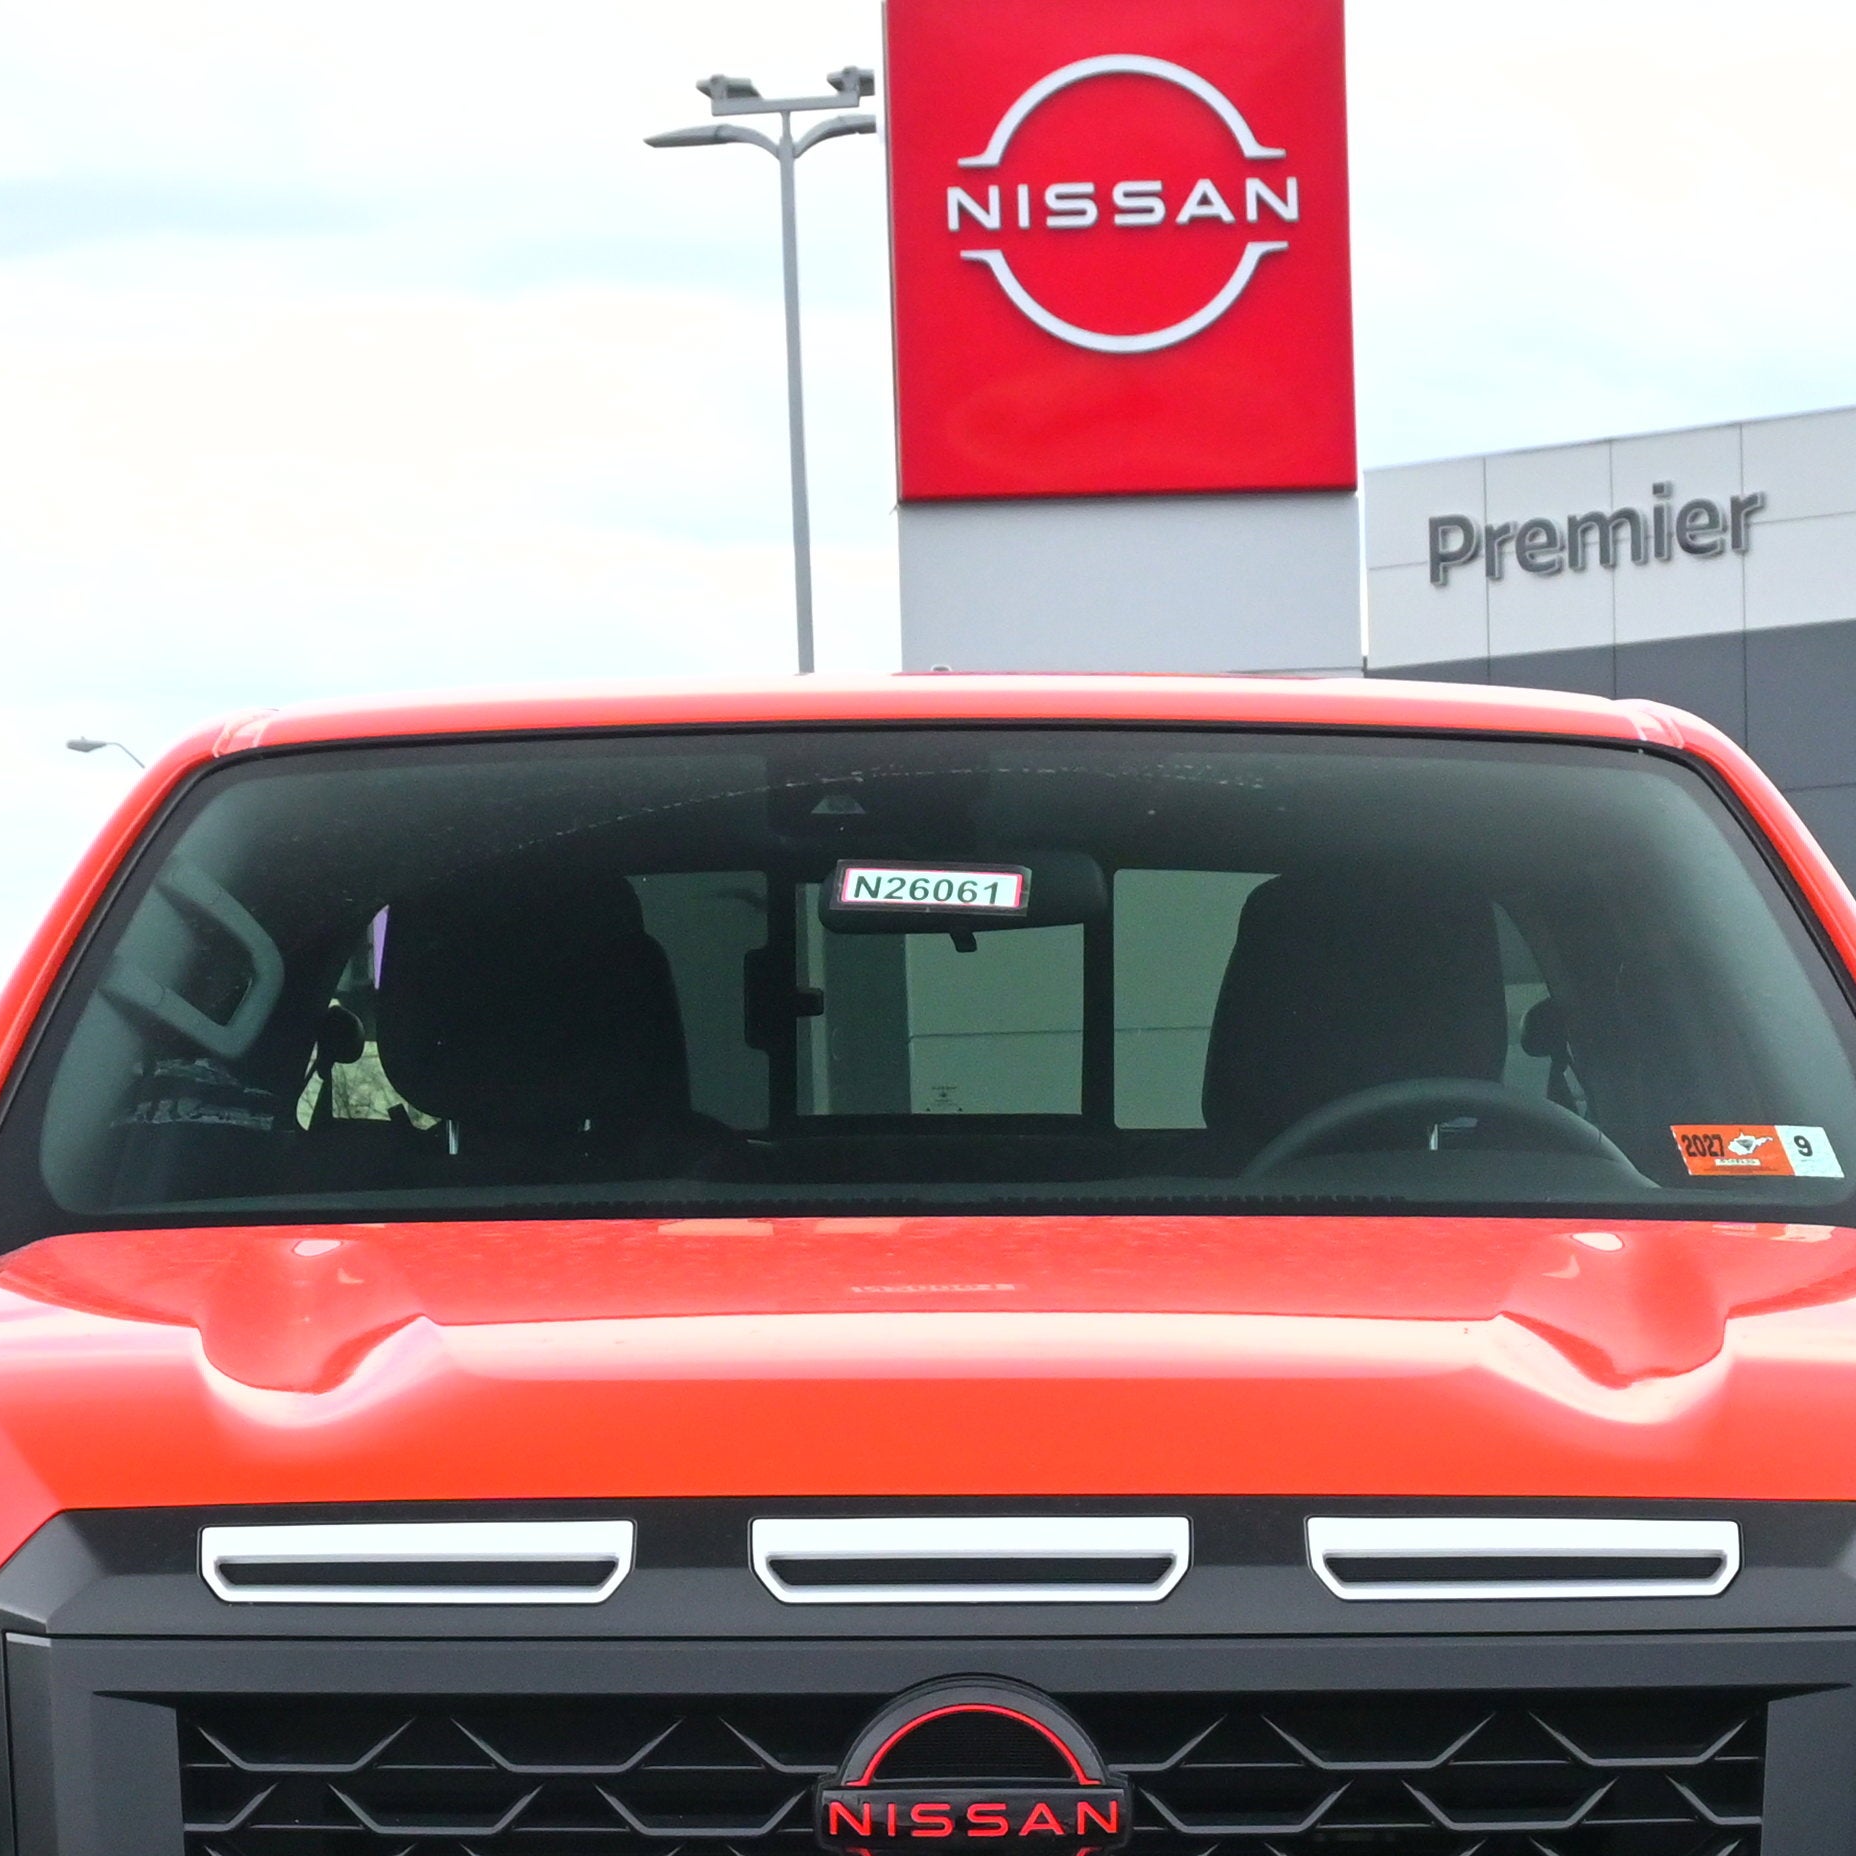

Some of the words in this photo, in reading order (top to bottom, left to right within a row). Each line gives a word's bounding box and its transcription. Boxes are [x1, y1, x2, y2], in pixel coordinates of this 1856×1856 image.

[946, 176, 1300, 232] NISSAN
[1428, 481, 1765, 586] Premier
[853, 874, 1000, 905] N26061
[1681, 1133, 1725, 1158] 2027
[1793, 1134, 1813, 1157] 9
[827, 1800, 1120, 1838] NISSAN
